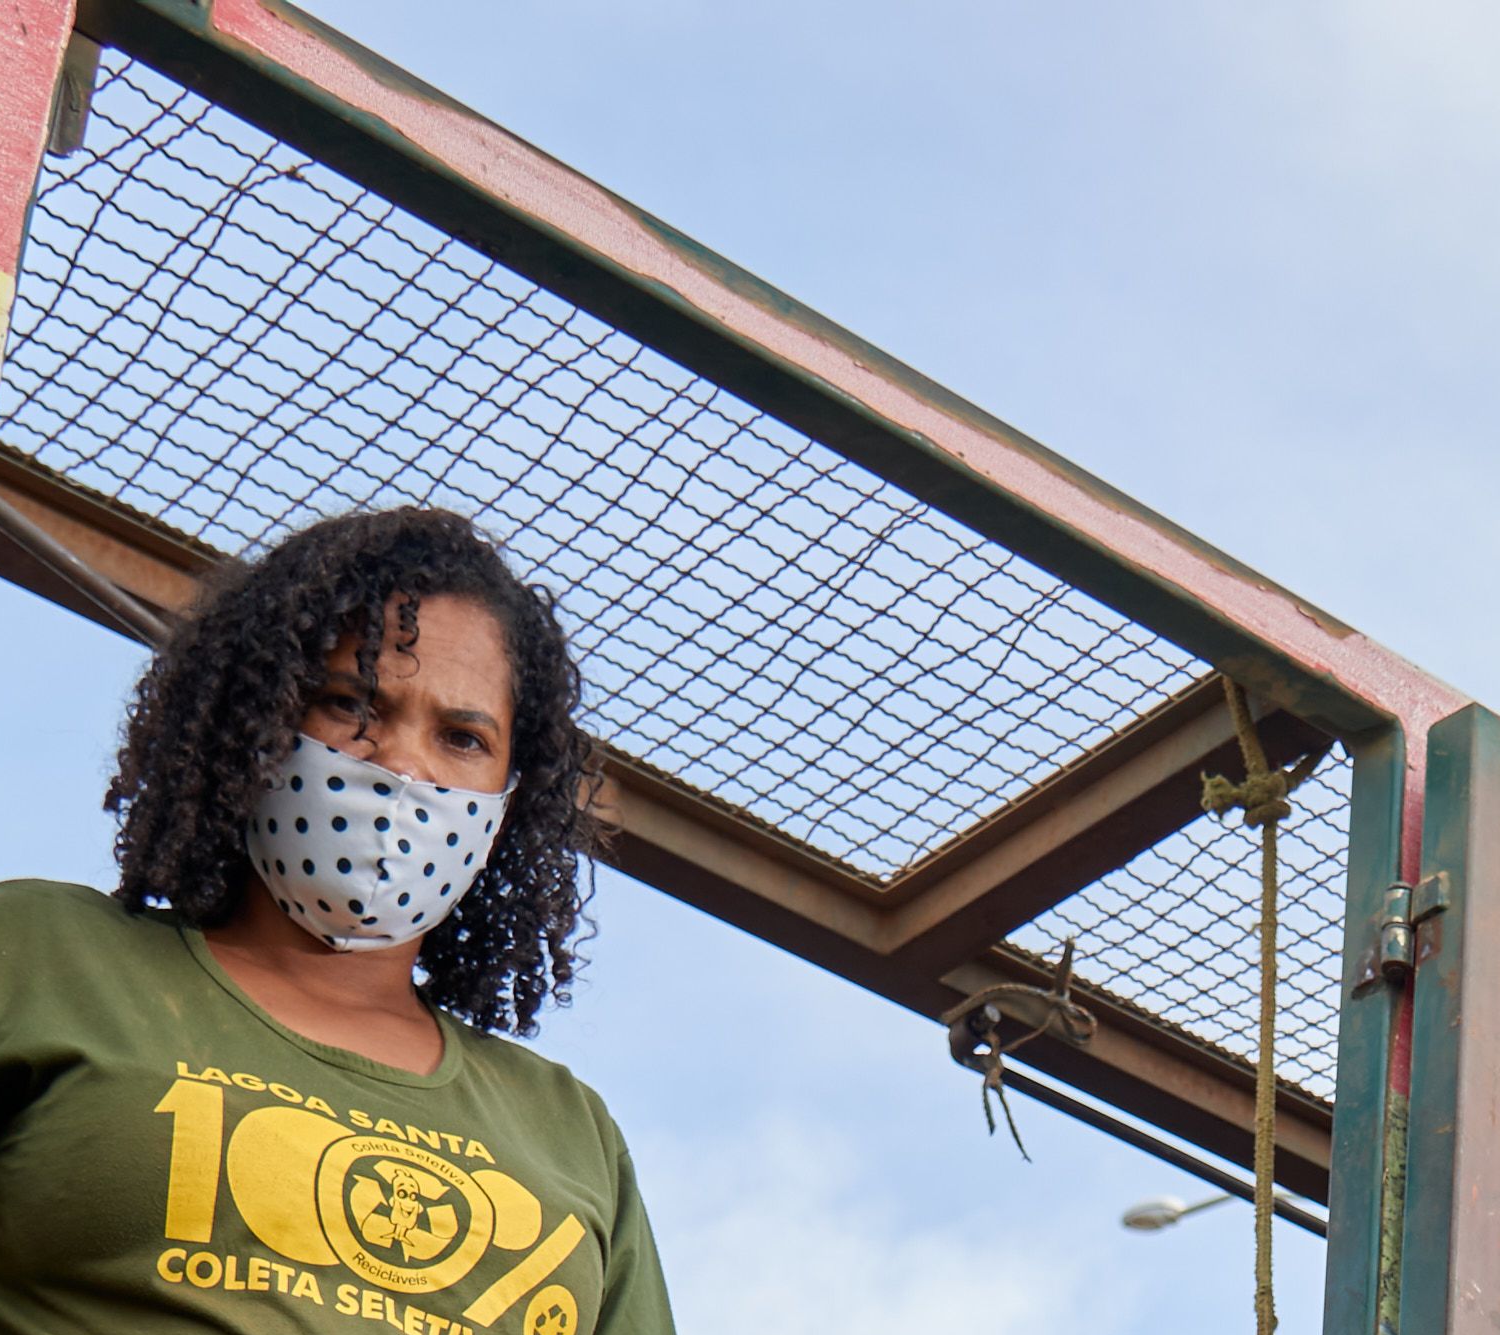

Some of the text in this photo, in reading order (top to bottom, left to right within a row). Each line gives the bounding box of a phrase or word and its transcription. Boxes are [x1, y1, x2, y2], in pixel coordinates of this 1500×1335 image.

[176, 1061, 496, 1164] LAGOA SANTA
[351, 1141, 466, 1186] Coleta Seletiva
[156, 1248, 325, 1306] COLETA
[352, 1251, 429, 1286] Recicláveis
